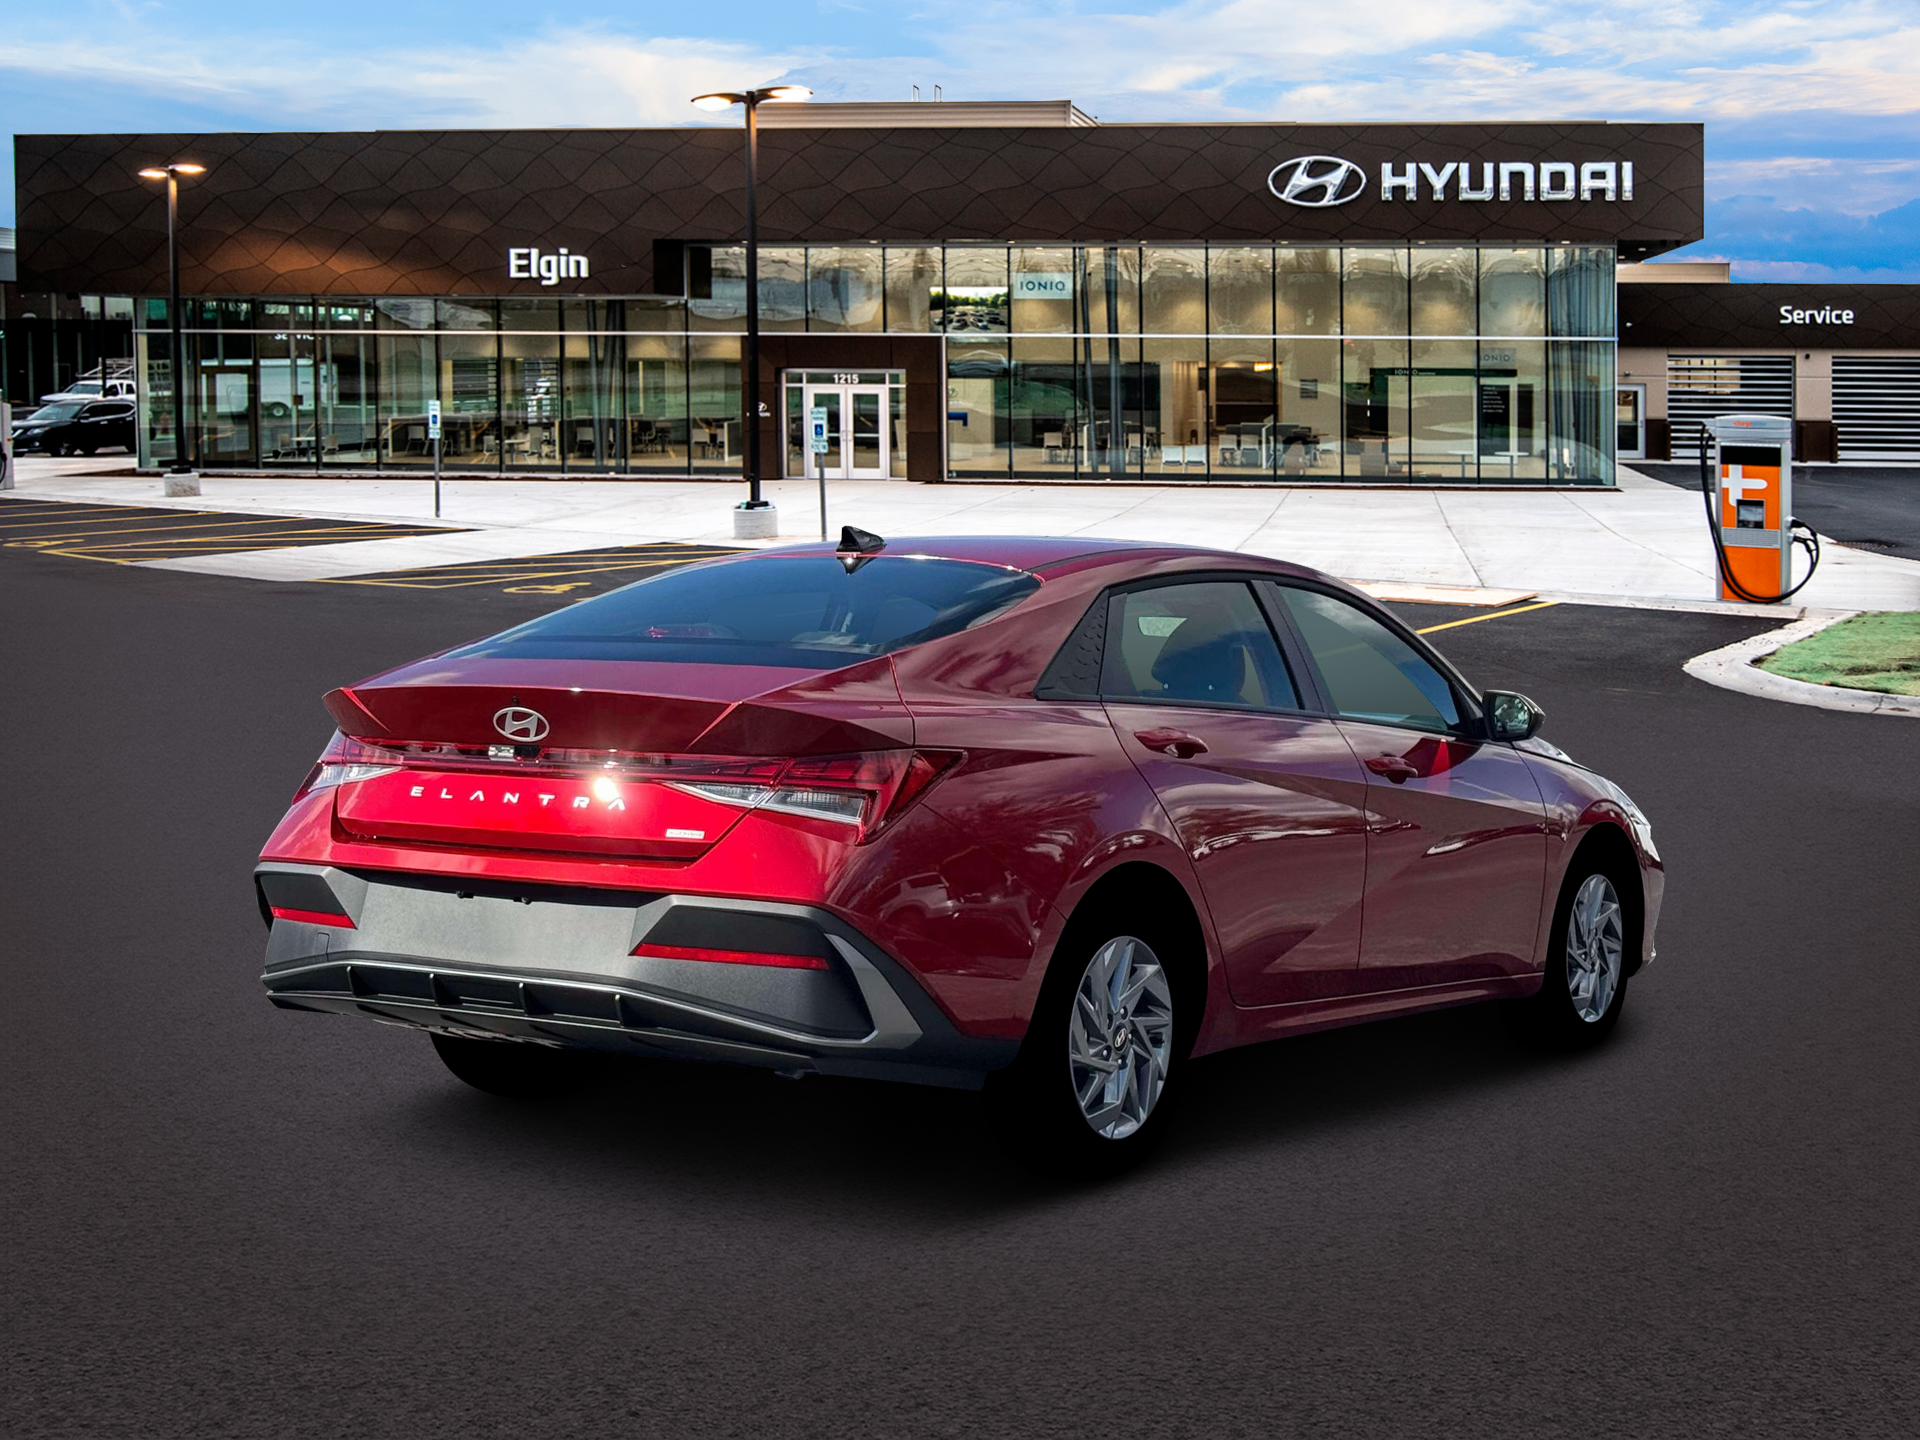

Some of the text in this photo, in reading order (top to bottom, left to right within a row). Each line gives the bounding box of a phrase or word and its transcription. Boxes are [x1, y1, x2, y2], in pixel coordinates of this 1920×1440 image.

[1380, 161, 1633, 202] HYUNDAI
[508, 247, 590, 286] Elgin
[1020, 280, 1066, 291] IONIQ
[1779, 305, 1855, 325] Service
[833, 373, 860, 385] 1215
[410, 786, 625, 811] ELANTRA
